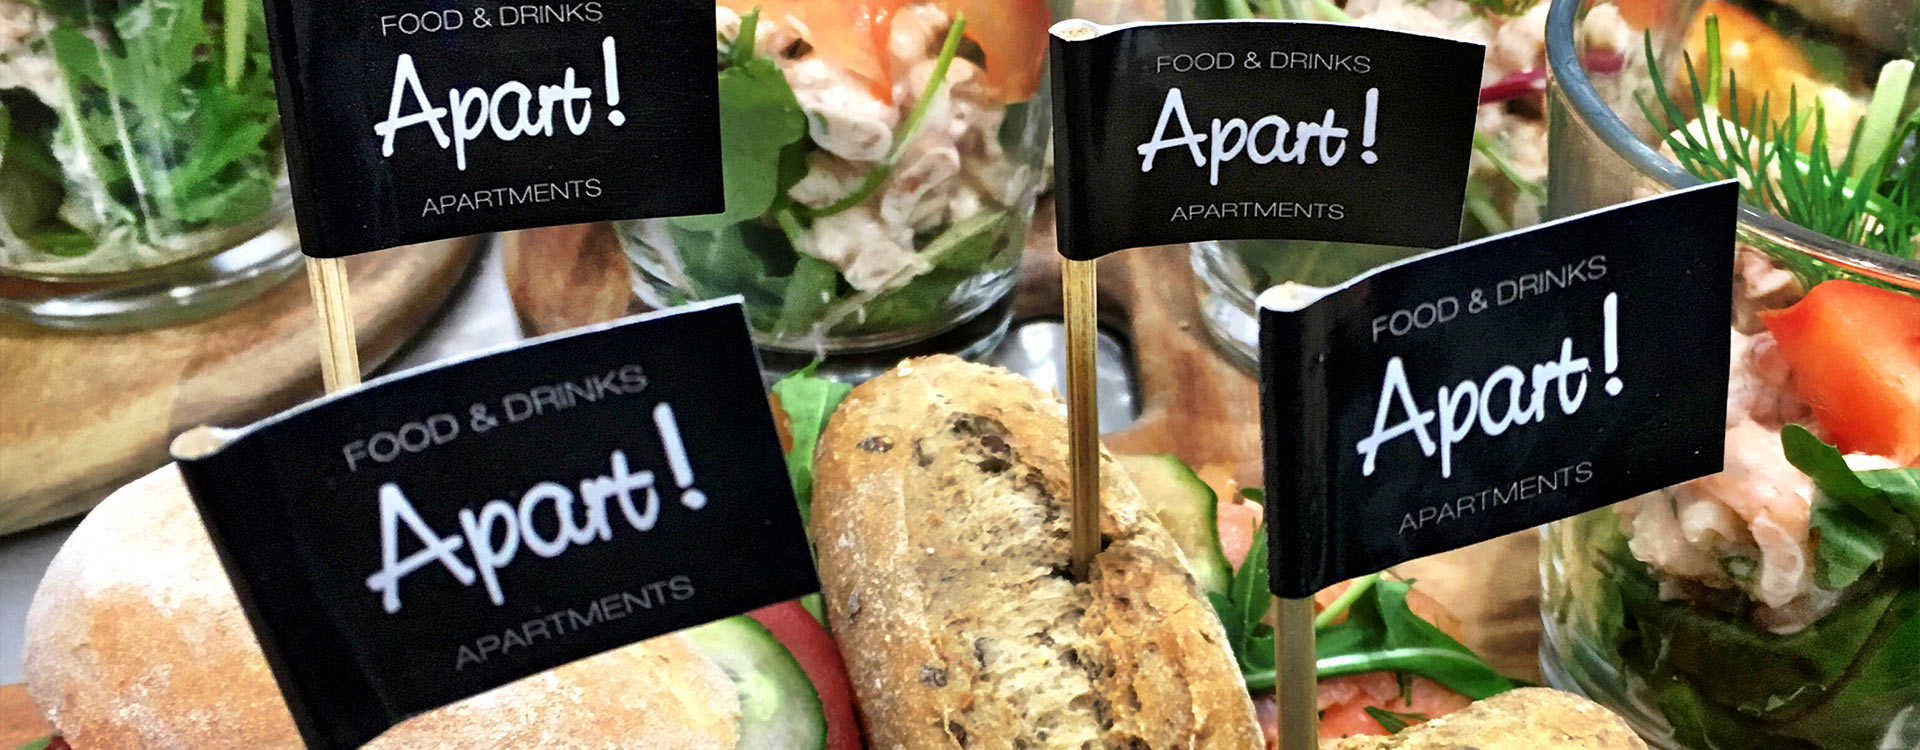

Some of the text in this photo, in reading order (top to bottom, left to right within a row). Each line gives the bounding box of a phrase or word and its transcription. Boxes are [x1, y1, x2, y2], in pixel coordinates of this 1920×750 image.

[380, 2, 603, 37] FOOD & DRINKS
[1157, 51, 1371, 74] FOOD & DRINKS
[421, 178, 602, 218] APARTMENTS
[1171, 202, 1345, 222] APARTMENTS
[1372, 255, 1608, 342] FOOD & DRINKS
[343, 364, 647, 471] FOOD & DRINKS
[1399, 461, 1594, 534] APARTMENTS
[455, 574, 695, 671] APARTMENTS
